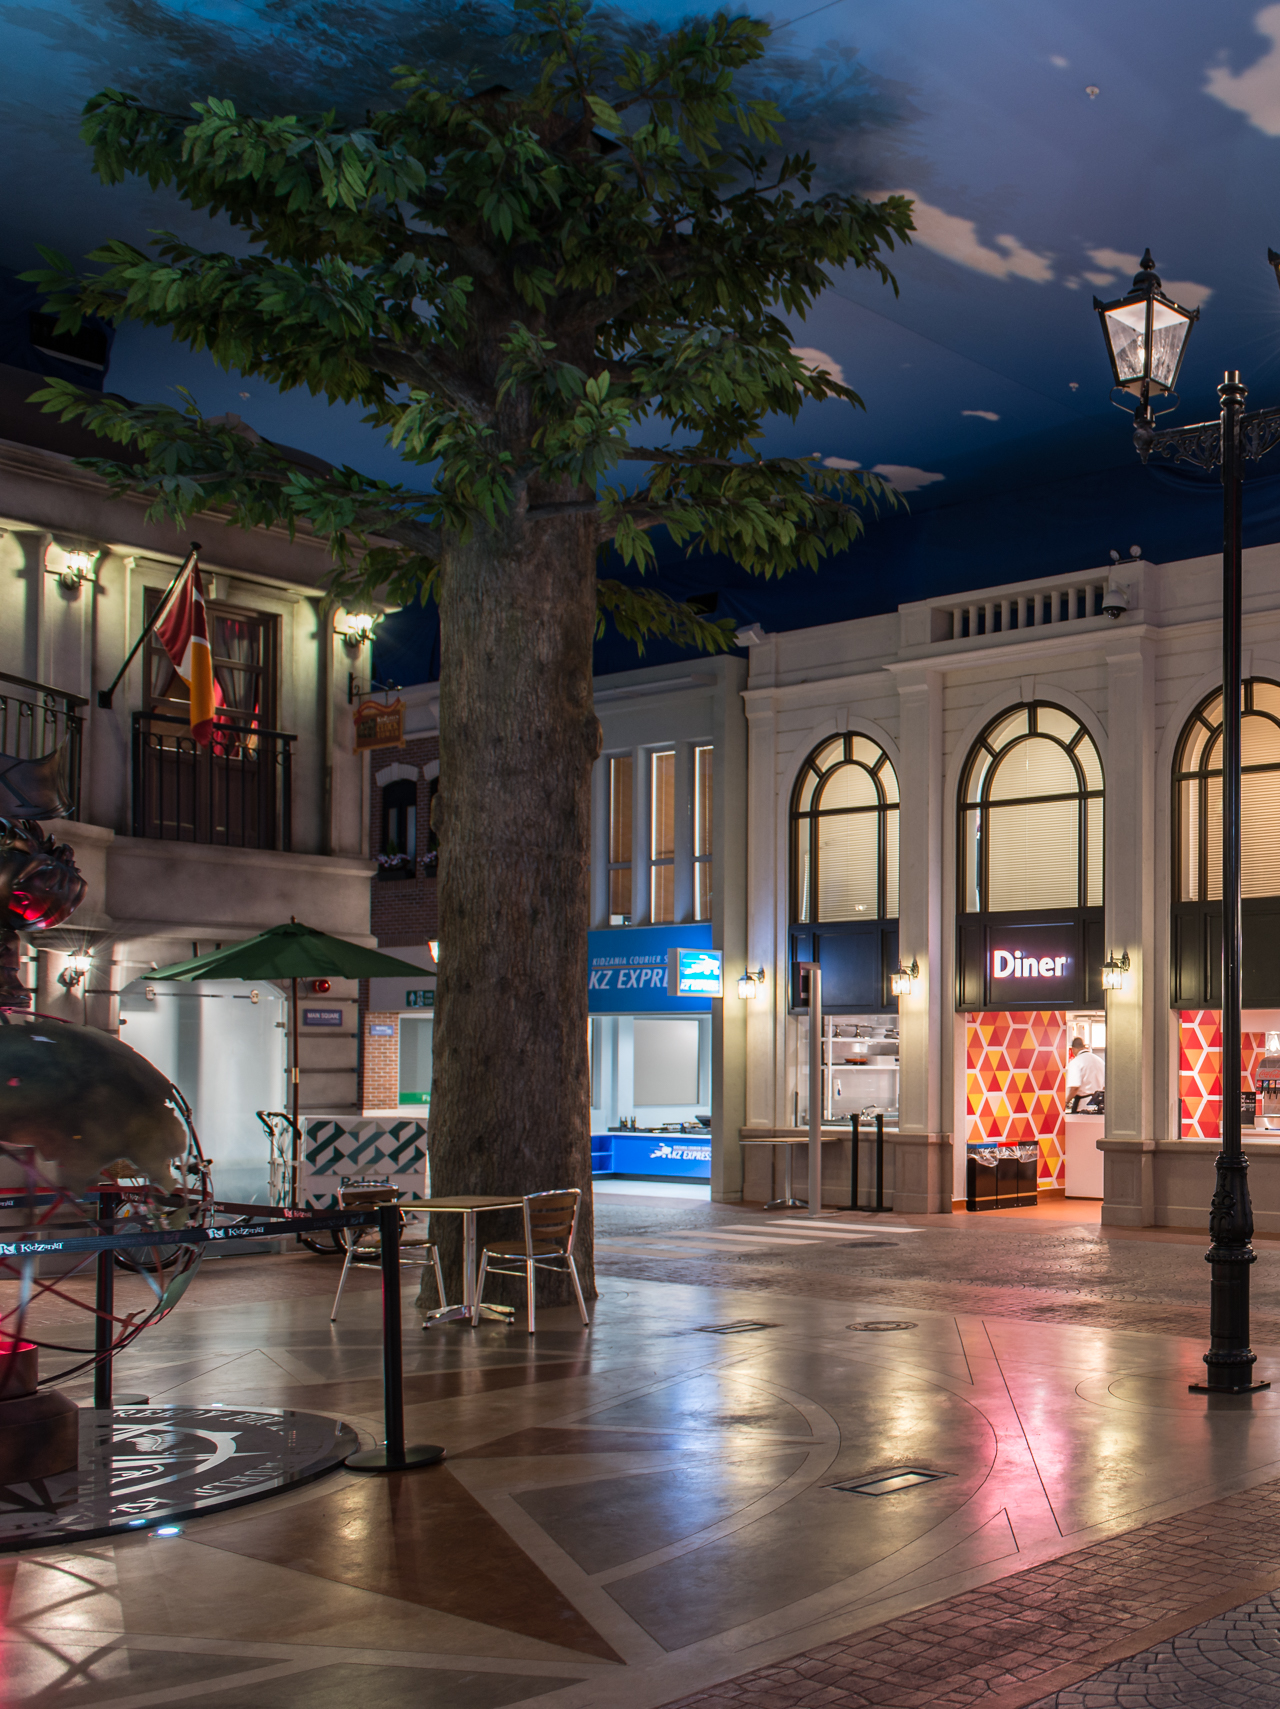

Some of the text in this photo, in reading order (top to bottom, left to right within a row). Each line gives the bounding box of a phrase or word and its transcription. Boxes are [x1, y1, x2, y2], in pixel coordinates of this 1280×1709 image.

[592, 957, 627, 966] KIDZANIA
[629, 955, 661, 965] COURIER
[993, 949, 1067, 978] Diner
[588, 970, 613, 989] KZ
[320, 1012, 340, 1020] SQUARE
[671, 1150, 683, 1160] KZ
[228, 1226, 265, 1237] KidZania
[20, 1242, 65, 1253] KidZania
